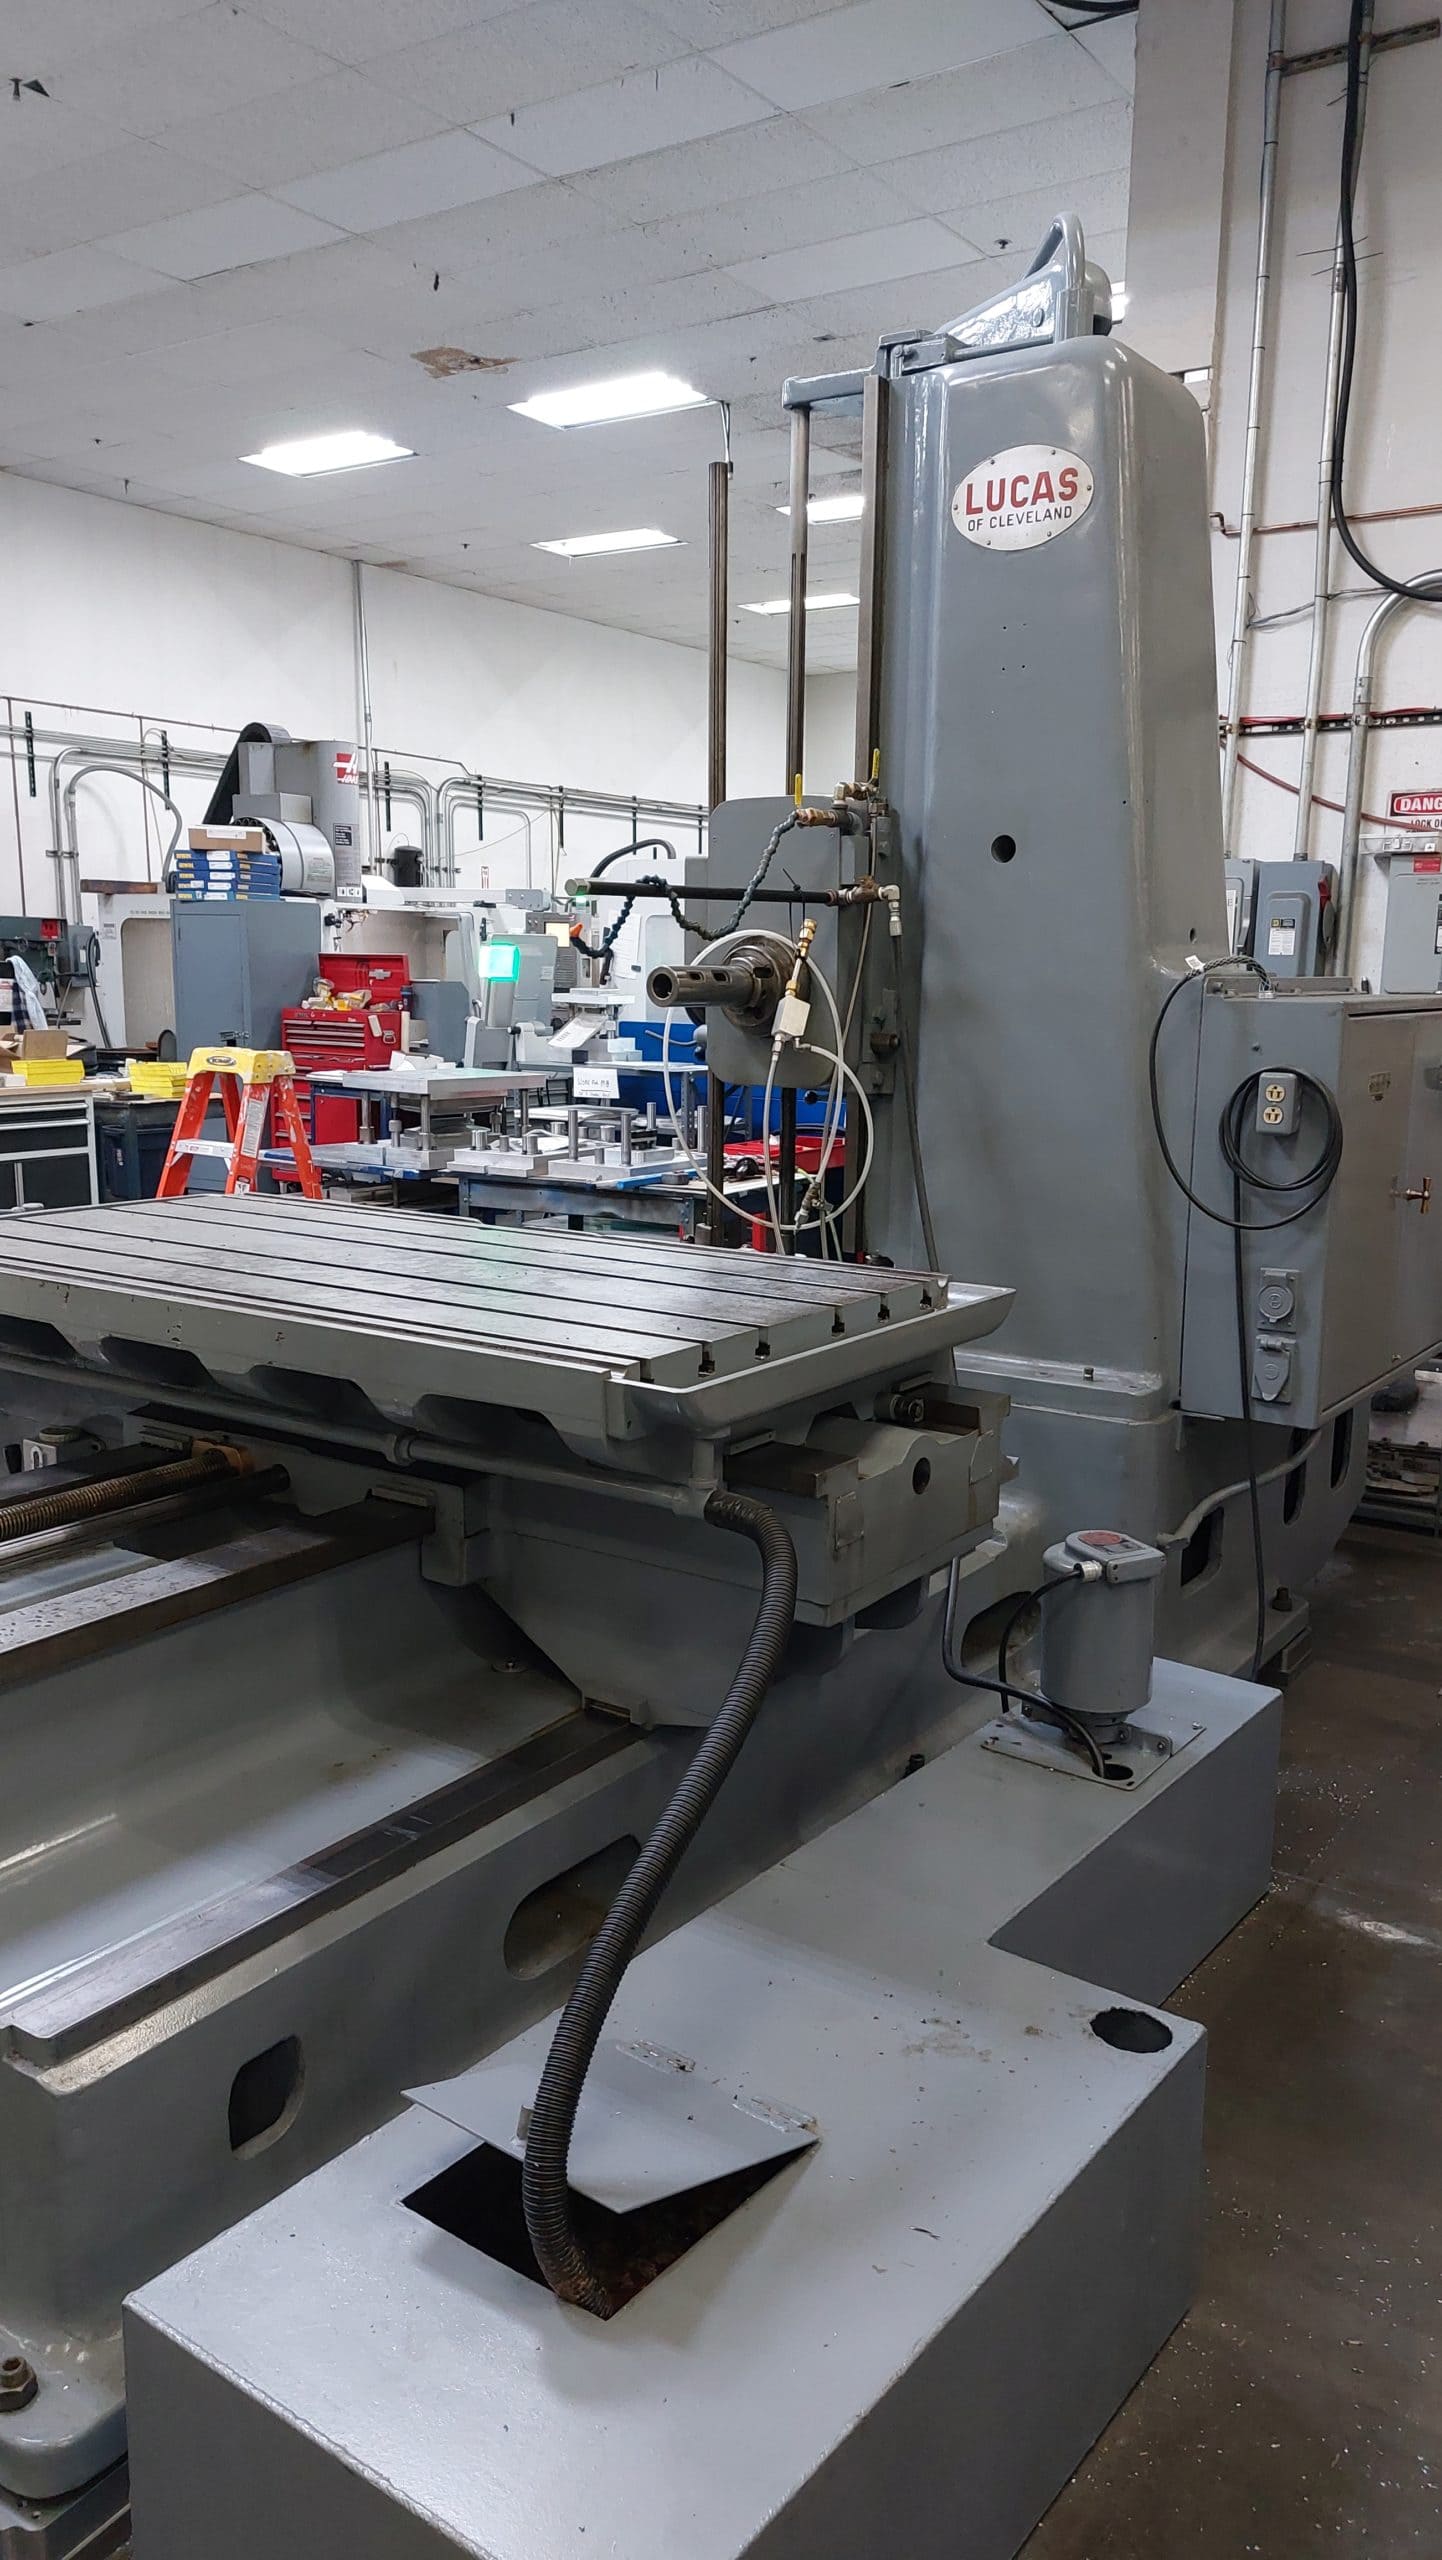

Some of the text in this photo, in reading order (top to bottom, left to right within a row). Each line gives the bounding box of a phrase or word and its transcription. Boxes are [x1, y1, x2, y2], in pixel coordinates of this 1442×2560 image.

[965, 467, 1079, 515] LUCAS
[967, 505, 1072, 532] OF CLEVELAND
